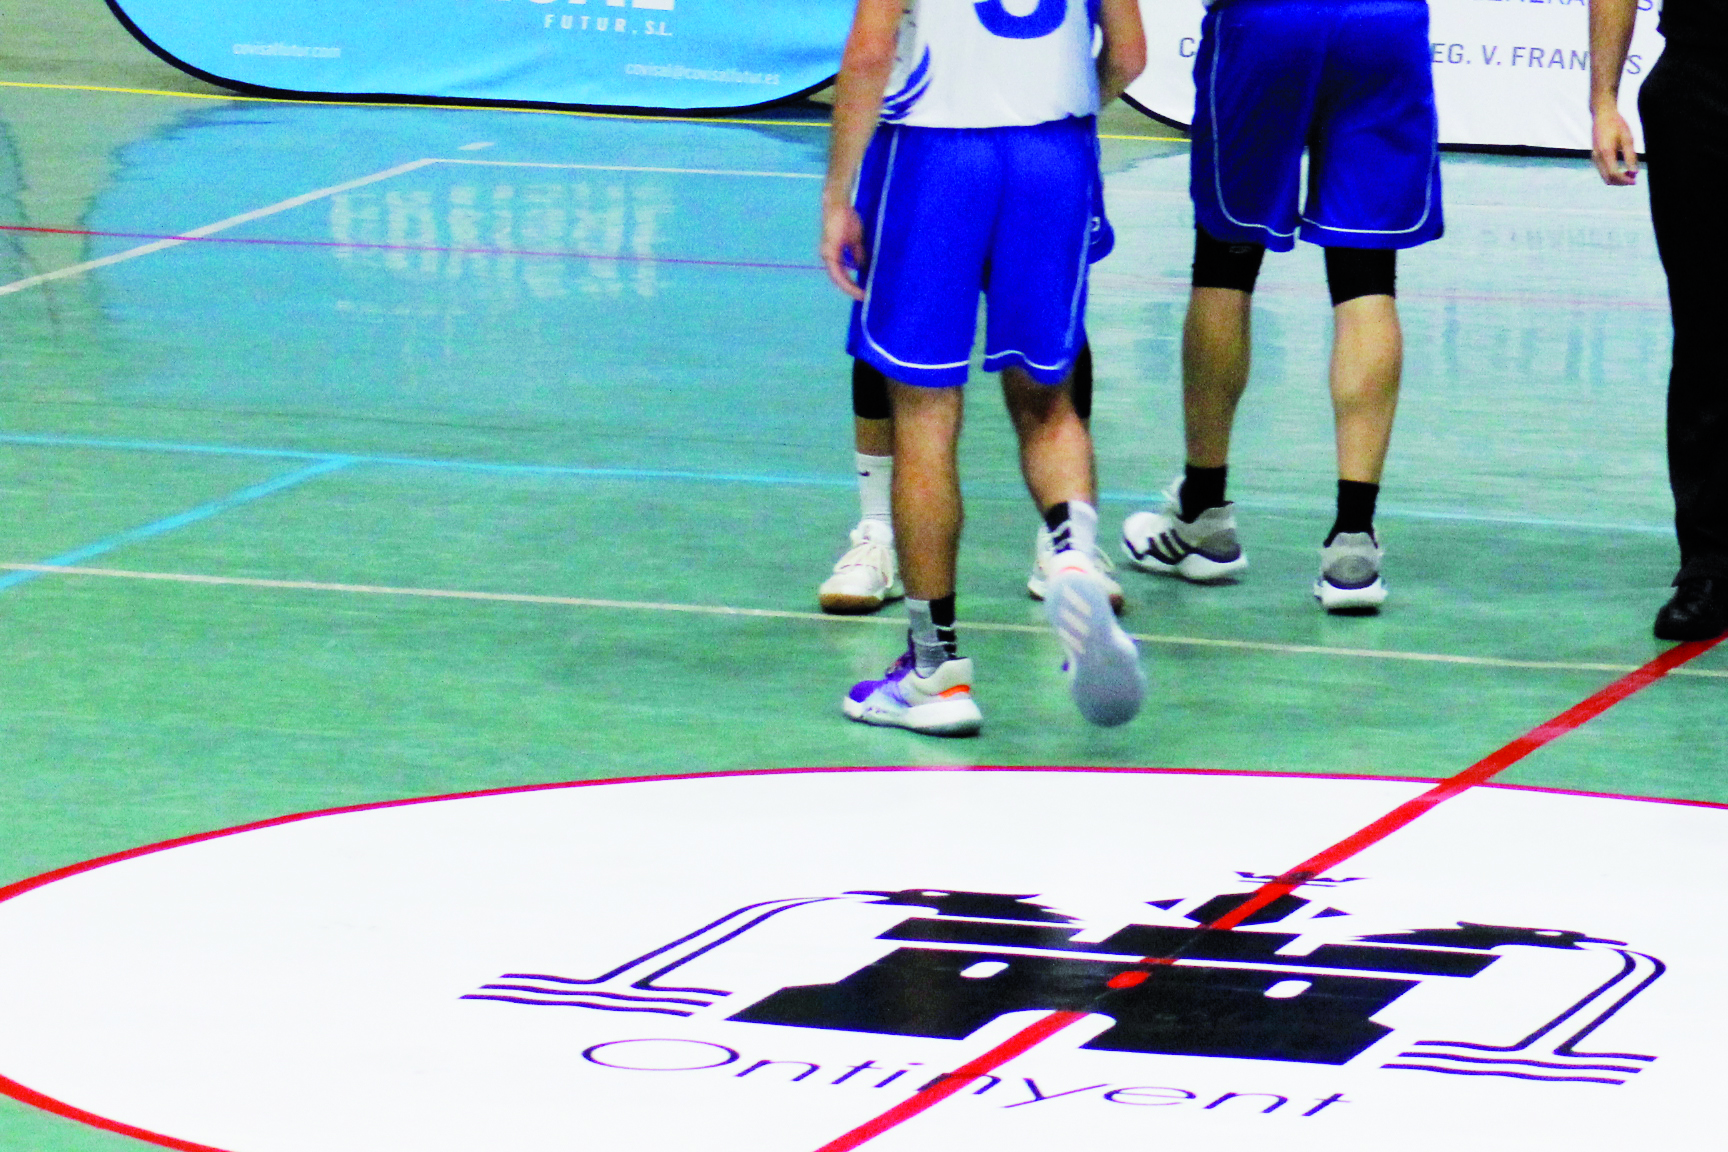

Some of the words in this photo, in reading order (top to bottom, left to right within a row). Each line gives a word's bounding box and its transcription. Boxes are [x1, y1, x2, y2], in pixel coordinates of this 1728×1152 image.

[1481, 44, 1501, 66] V.
[1511, 46, 1643, 75] FRANS
[582, 1038, 1352, 1117] Ontinyent
